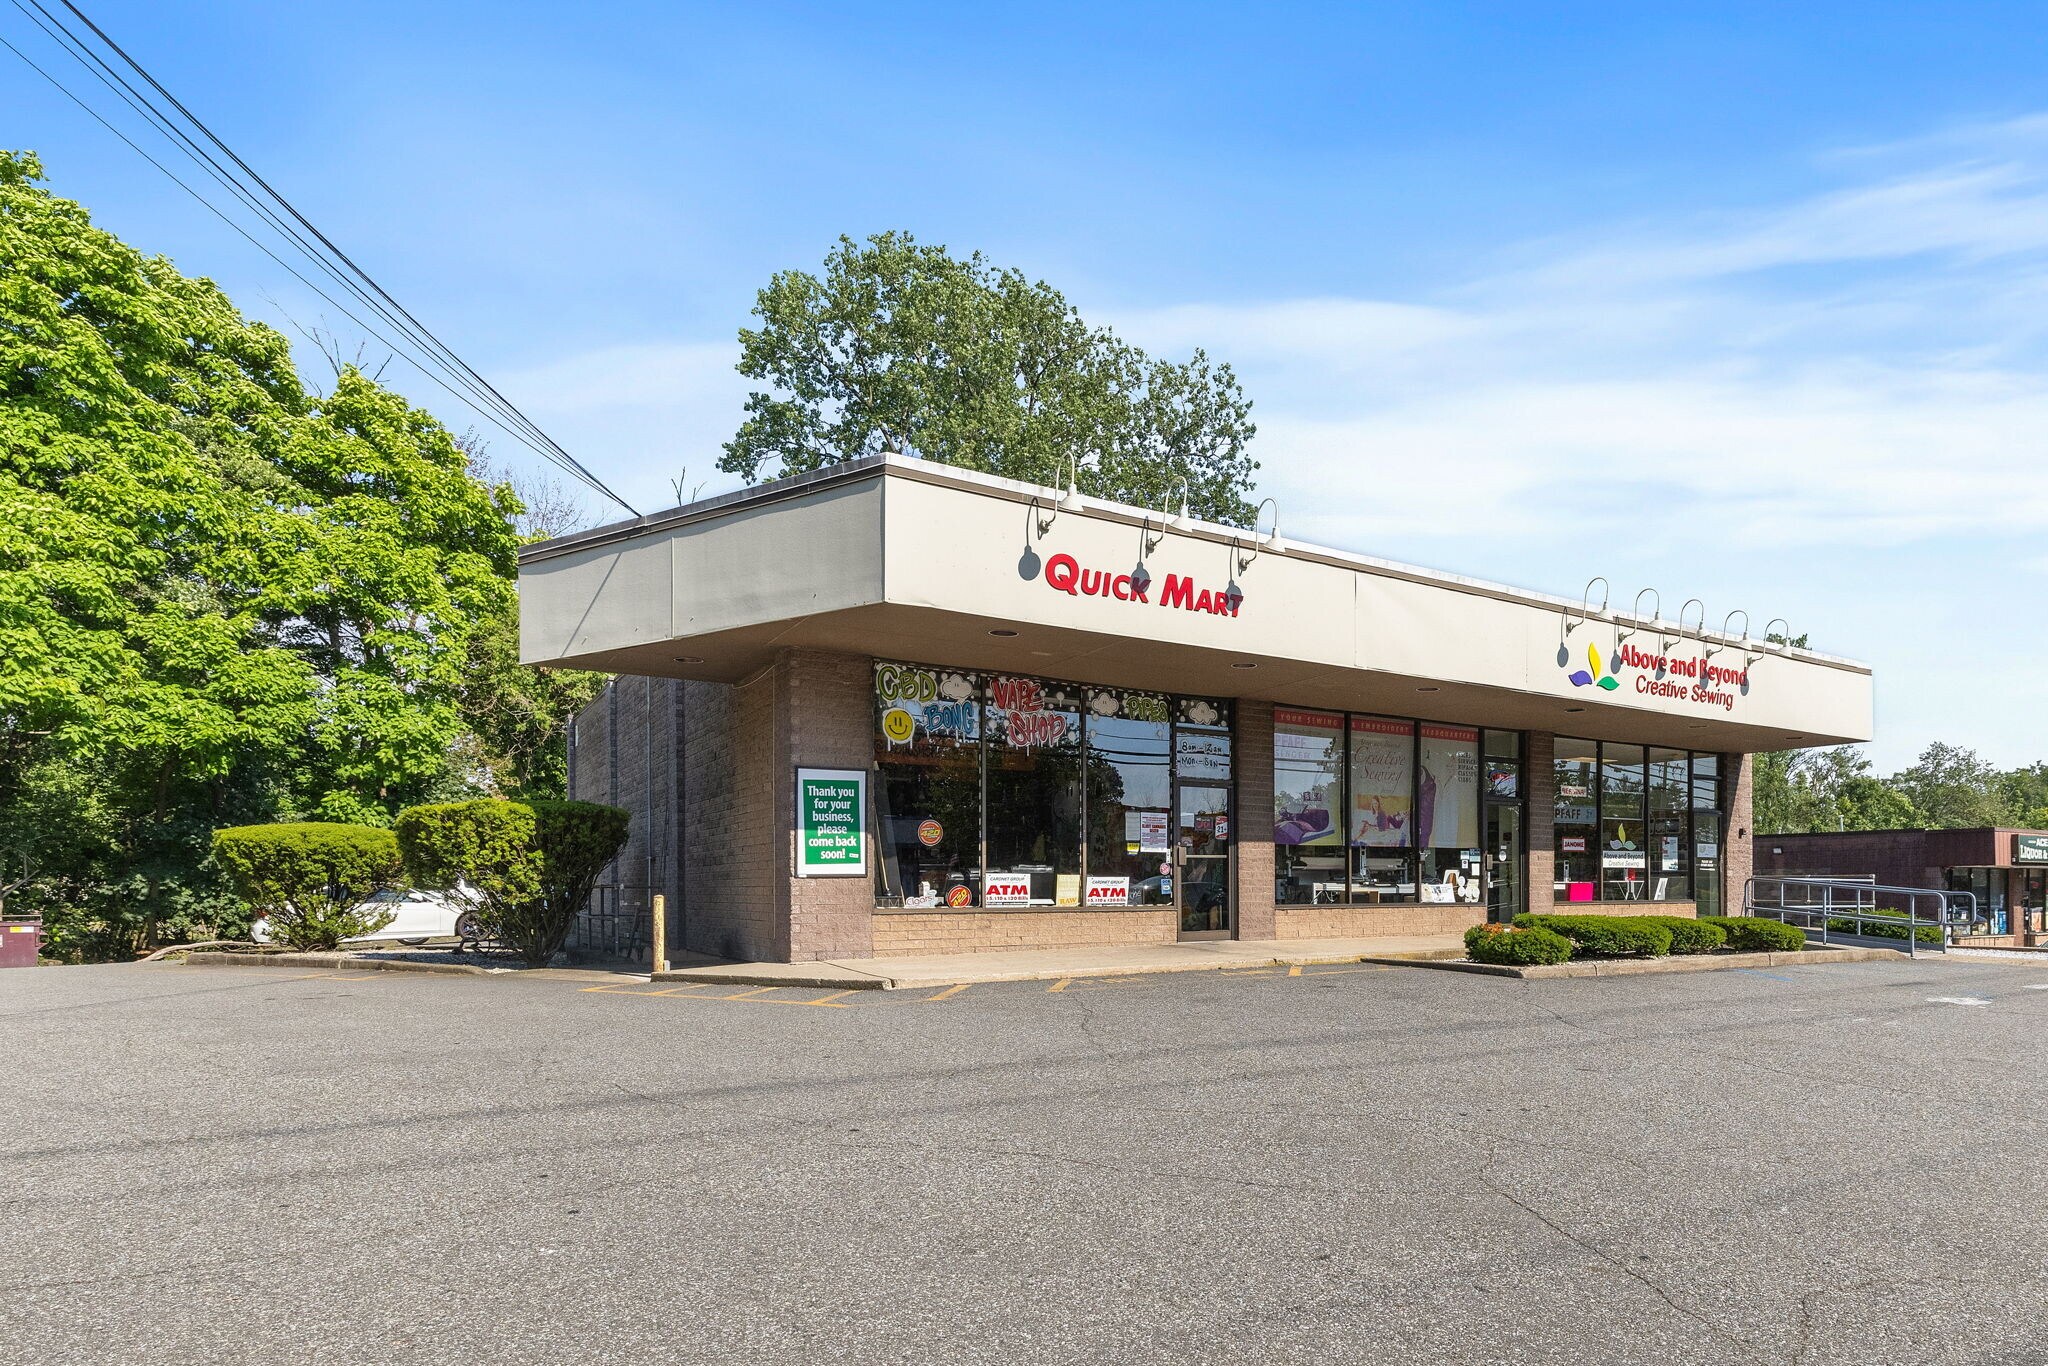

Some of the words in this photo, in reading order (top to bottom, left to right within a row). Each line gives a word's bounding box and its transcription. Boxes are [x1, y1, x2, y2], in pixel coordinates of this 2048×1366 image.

[1045, 553, 1151, 604] QUICK
[1159, 573, 1244, 618] MART
[1620, 644, 1667, 672] Above
[1670, 656, 1697, 678] and
[1700, 658, 1748, 687] Beyond
[877, 664, 938, 702] CBD
[990, 678, 1044, 713] VAPE
[1636, 675, 1688, 700] Creative
[1691, 684, 1734, 711] Sewing
[924, 701, 975, 733] BONG
[1307, 716, 1338, 726] SEWING
[1008, 710, 1067, 747] SHOP
[1354, 745, 1407, 766] Creative
[1360, 764, 1404, 792] Sewing
[807, 785, 837, 797] Thank
[838, 788, 855, 799] you
[814, 798, 828, 809] for
[830, 801, 851, 812] your
[812, 811, 854, 823] business,
[1554, 808, 1581, 820] PFAFF
[817, 823, 847, 836] please
[921, 829, 941, 837] 420
[808, 838, 834, 847] come
[835, 836, 857, 847] back
[820, 849, 846, 859] soon!
[1627, 853, 1644, 861] Beyond
[2020, 844, 2043, 860] LIQUOR
[986, 884, 1028, 895] ATM
[1088, 887, 1126, 898] ATM
[1059, 897, 1077, 905] RAW
